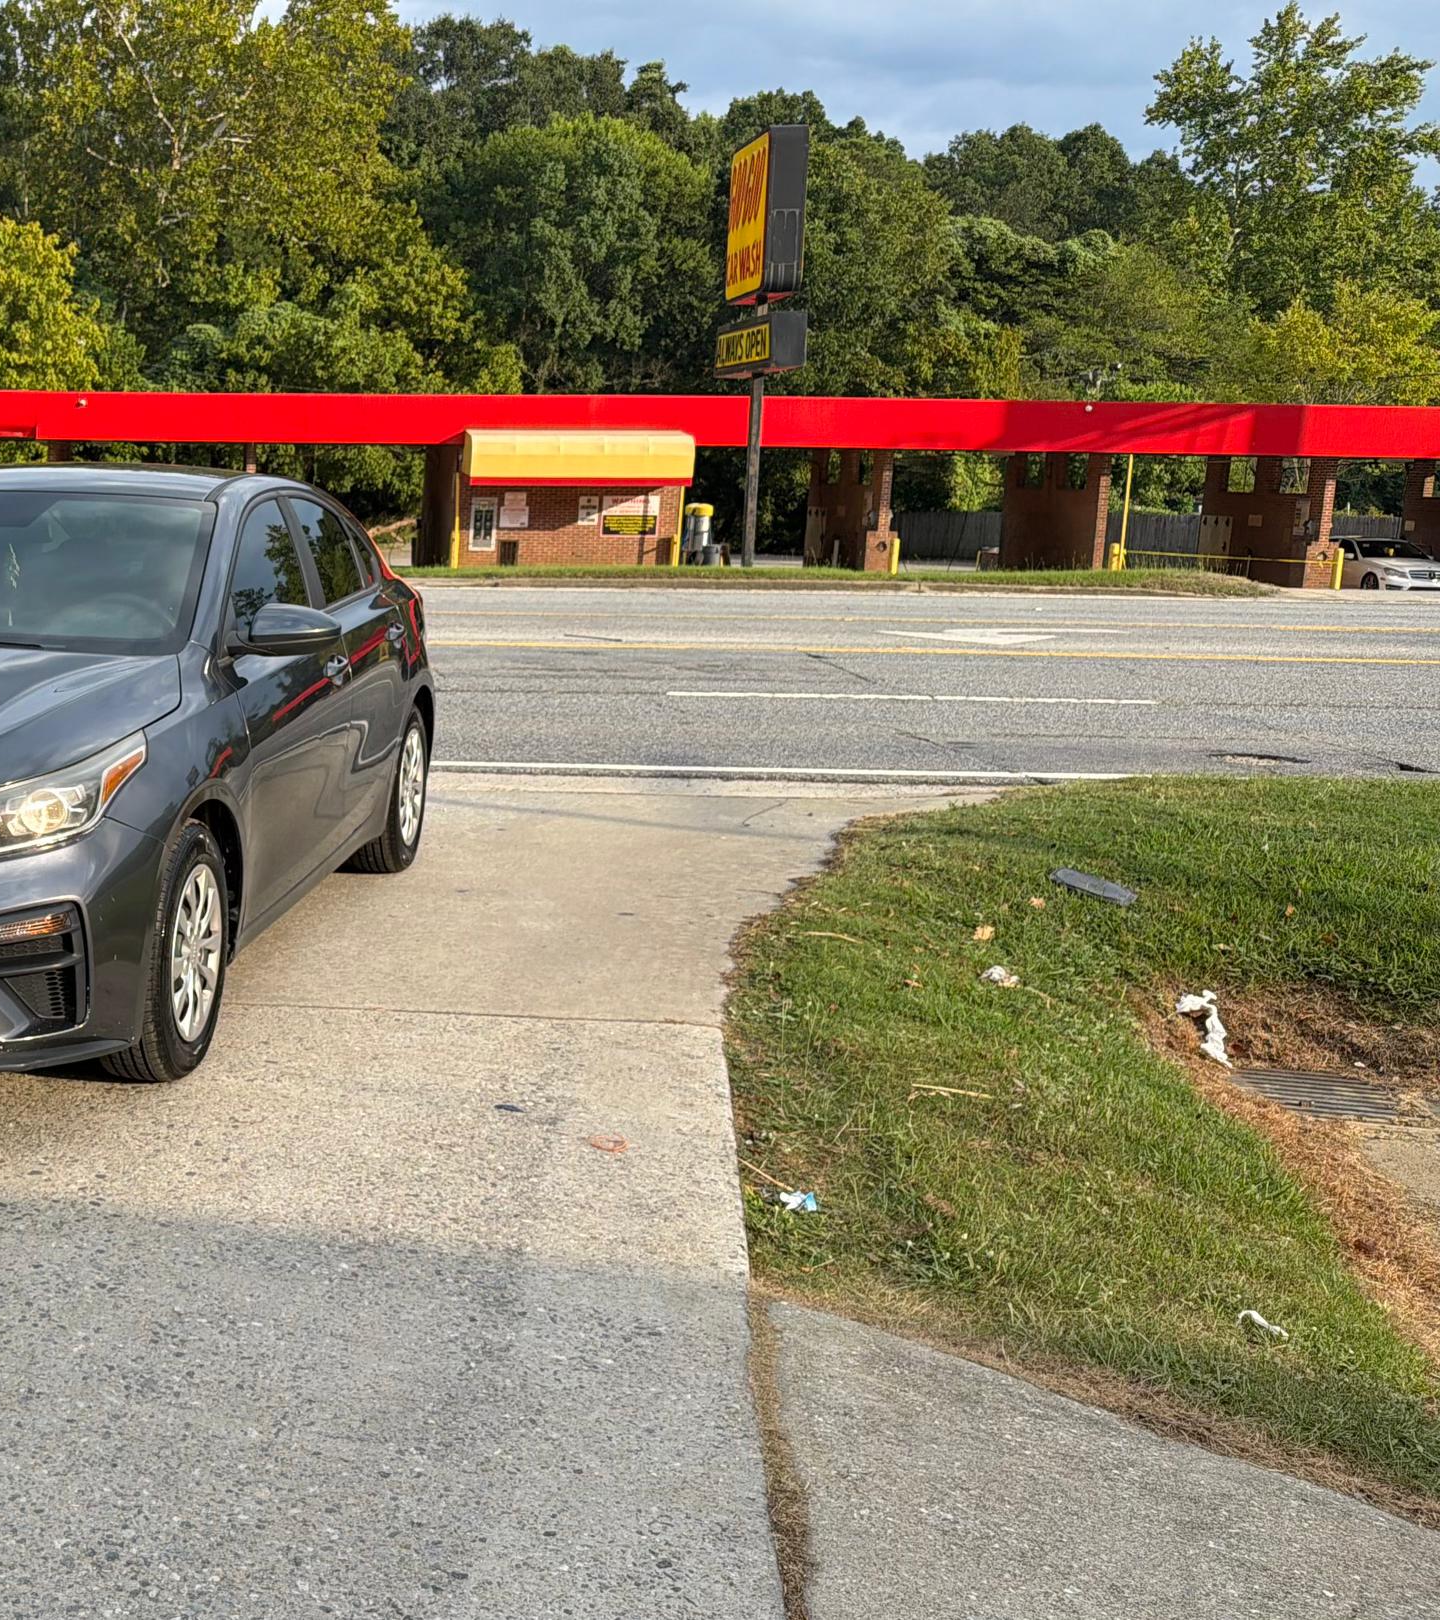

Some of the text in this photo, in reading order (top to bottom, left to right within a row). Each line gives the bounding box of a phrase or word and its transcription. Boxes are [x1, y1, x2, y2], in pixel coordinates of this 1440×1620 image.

[727, 240, 761, 287] CAR WASH
[717, 327, 767, 364] ALWAYS OPEN
